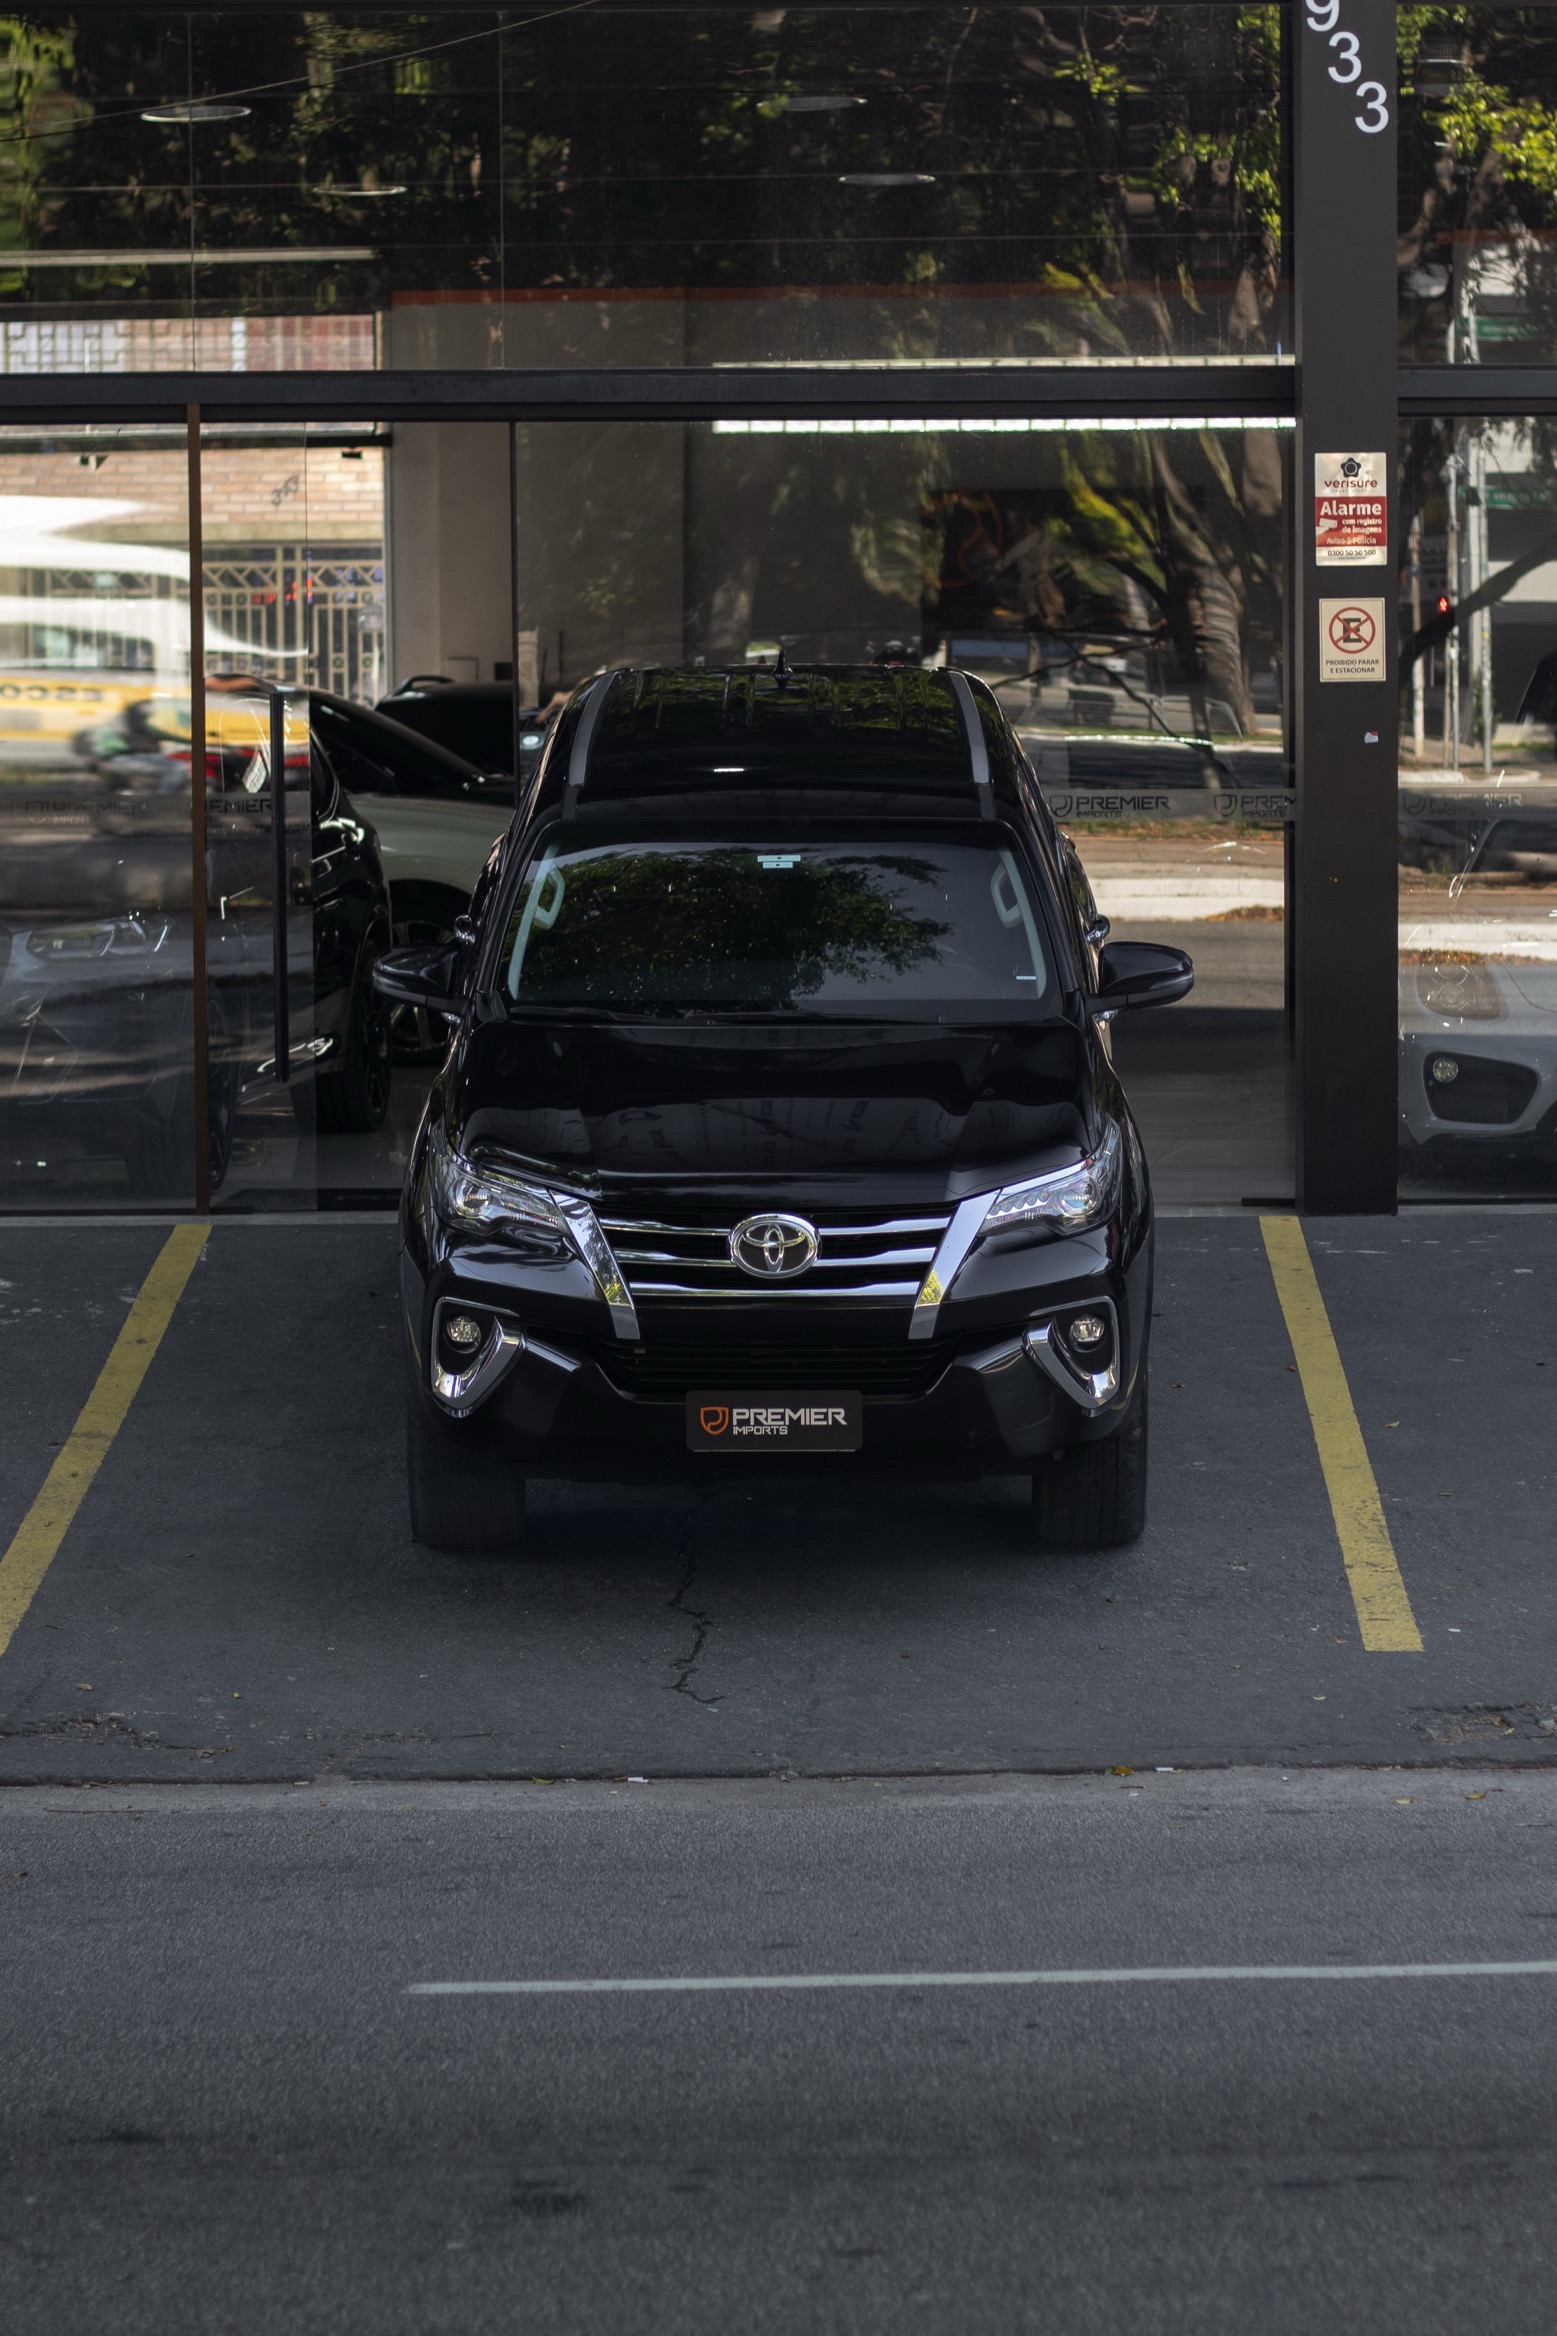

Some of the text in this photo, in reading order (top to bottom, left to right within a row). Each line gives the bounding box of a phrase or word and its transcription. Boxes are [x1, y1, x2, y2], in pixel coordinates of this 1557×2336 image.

[1324, 479, 1378, 489] verisure
[1320, 500, 1382, 516] Alarme
[1357, 518, 1383, 527] registro
[1342, 525, 1382, 535] de imagens
[1327, 536, 1345, 545] Aviso
[1328, 549, 1344, 557] 0300
[1076, 796, 1170, 810] PREMIER
[1076, 810, 1122, 818] IMPORTS
[733, 1408, 848, 1426] PREMIER
[733, 1426, 788, 1435] IMPORTS
